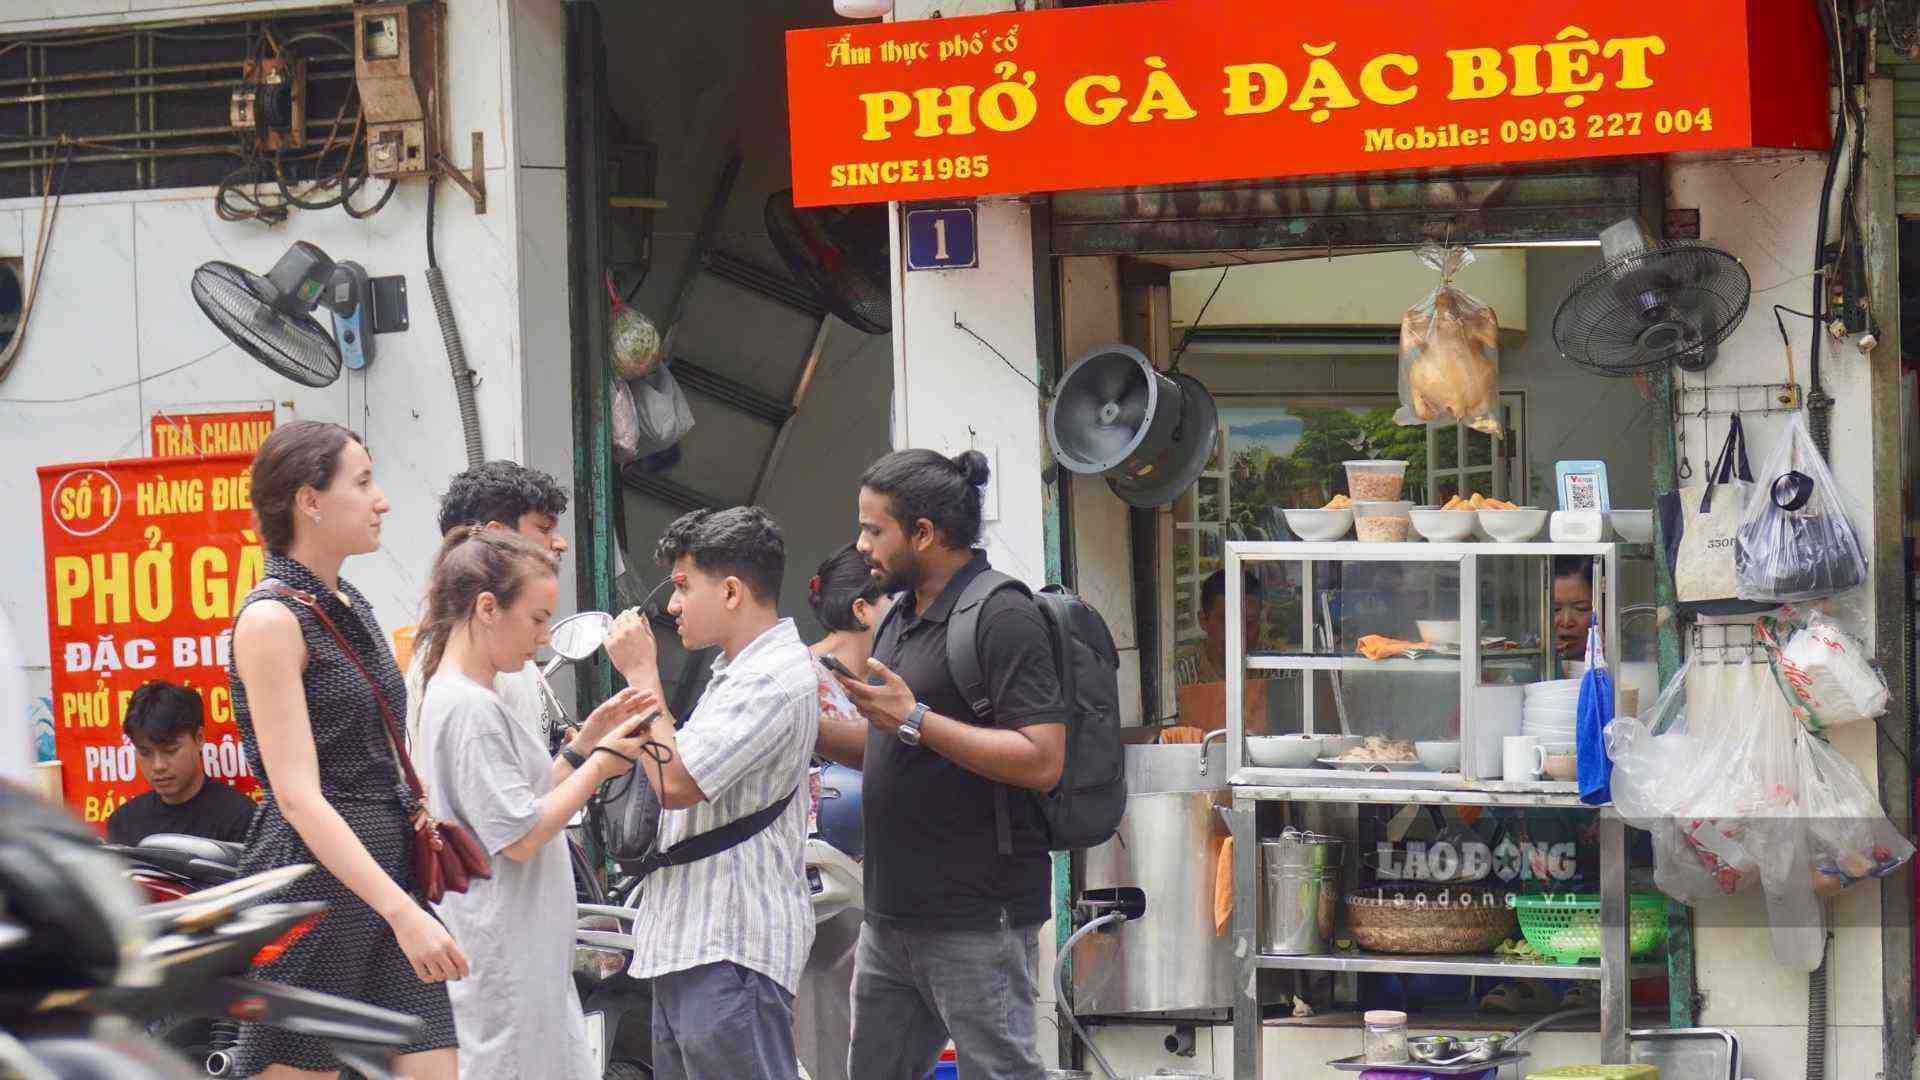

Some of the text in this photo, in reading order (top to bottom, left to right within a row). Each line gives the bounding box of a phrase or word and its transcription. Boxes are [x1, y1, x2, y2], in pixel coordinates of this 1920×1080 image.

[879, 39, 931, 65] thực
[937, 29, 989, 62] phố
[859, 25, 1667, 142] PHỞ GÀ ĐẶC BIỆT
[1364, 106, 1714, 153] Mobile: 0903 227 004
[932, 218, 949, 261] 1
[155, 416, 194, 457] TRÀ
[60, 474, 114, 521] SỐ 1
[136, 464, 253, 516] HÀNG ĐIẾ
[54, 525, 265, 627] PHỞ GÀ
[64, 629, 232, 677] ĐẶC BIỆ
[62, 679, 111, 728] PHỞ
